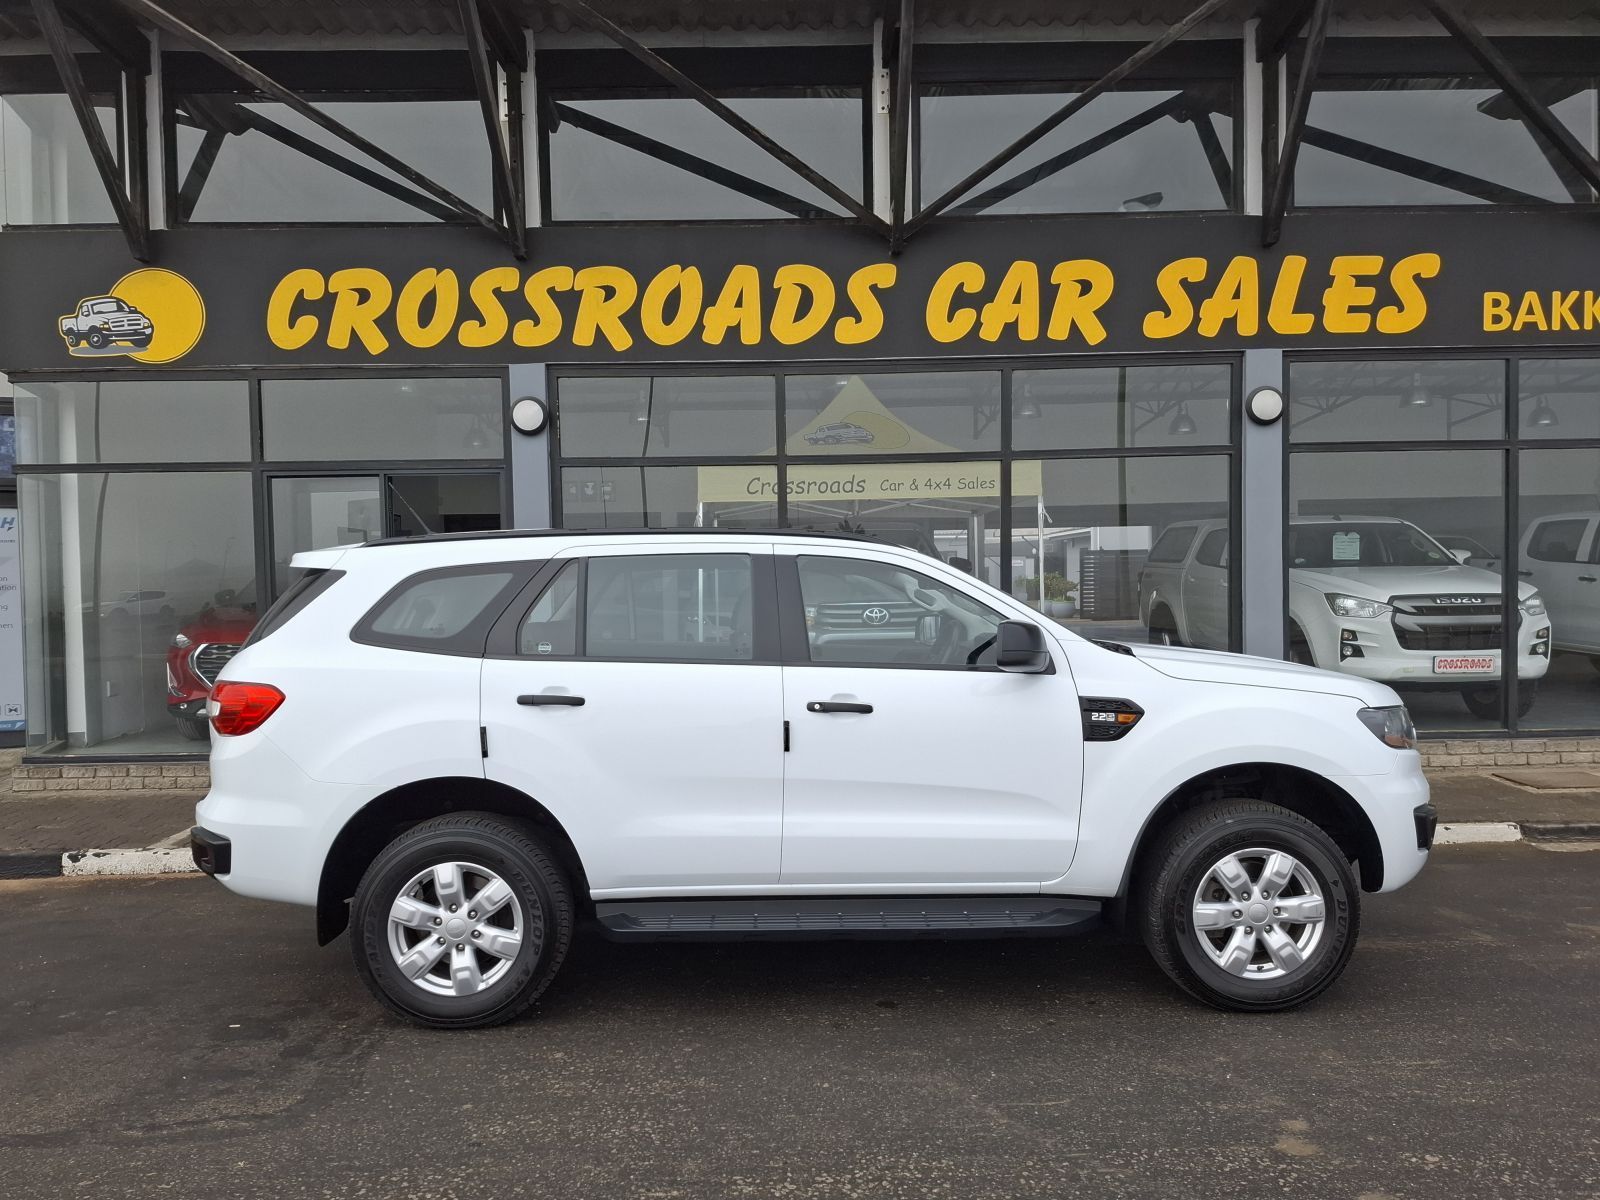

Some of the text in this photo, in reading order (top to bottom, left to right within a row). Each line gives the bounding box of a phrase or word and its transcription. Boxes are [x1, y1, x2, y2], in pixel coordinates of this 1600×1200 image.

[266, 252, 1441, 356] CROSSROADS CAR SALES
[880, 478, 905, 492] Car
[909, 477, 919, 491] &
[924, 477, 952, 491] 4x4
[957, 475, 996, 490] Sales
[1436, 595, 1482, 604] ISUZU
[1437, 658, 1493, 671] CROSSROADS
